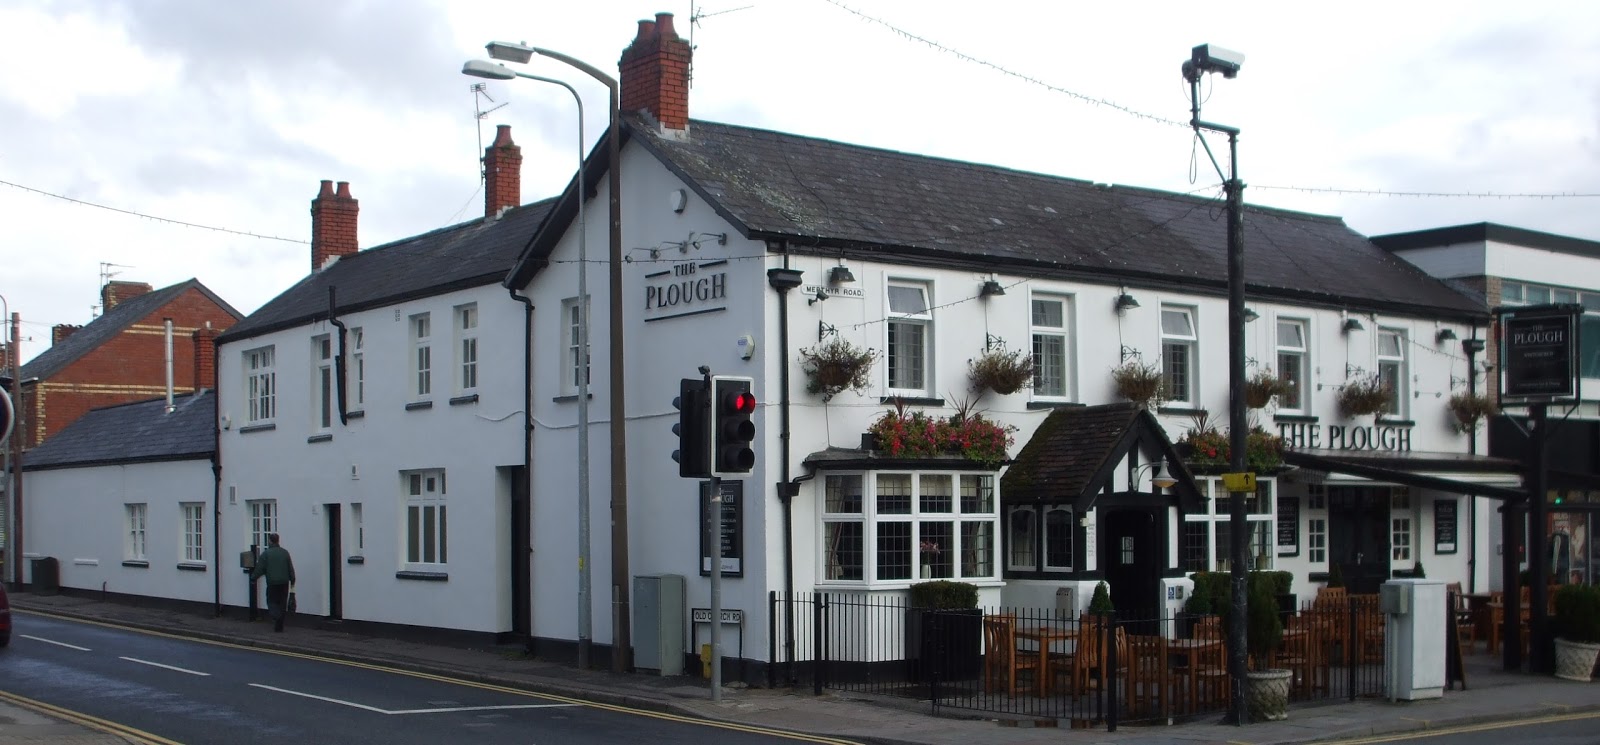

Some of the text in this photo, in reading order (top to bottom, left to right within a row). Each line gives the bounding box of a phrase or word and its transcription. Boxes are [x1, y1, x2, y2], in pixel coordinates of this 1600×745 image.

[673, 262, 696, 277] THE
[645, 272, 727, 310] PLOUGH
[1514, 330, 1563, 345] PLOUGH
[1276, 422, 1412, 452] THE PLOUGH
[695, 611, 707, 620] OLD
